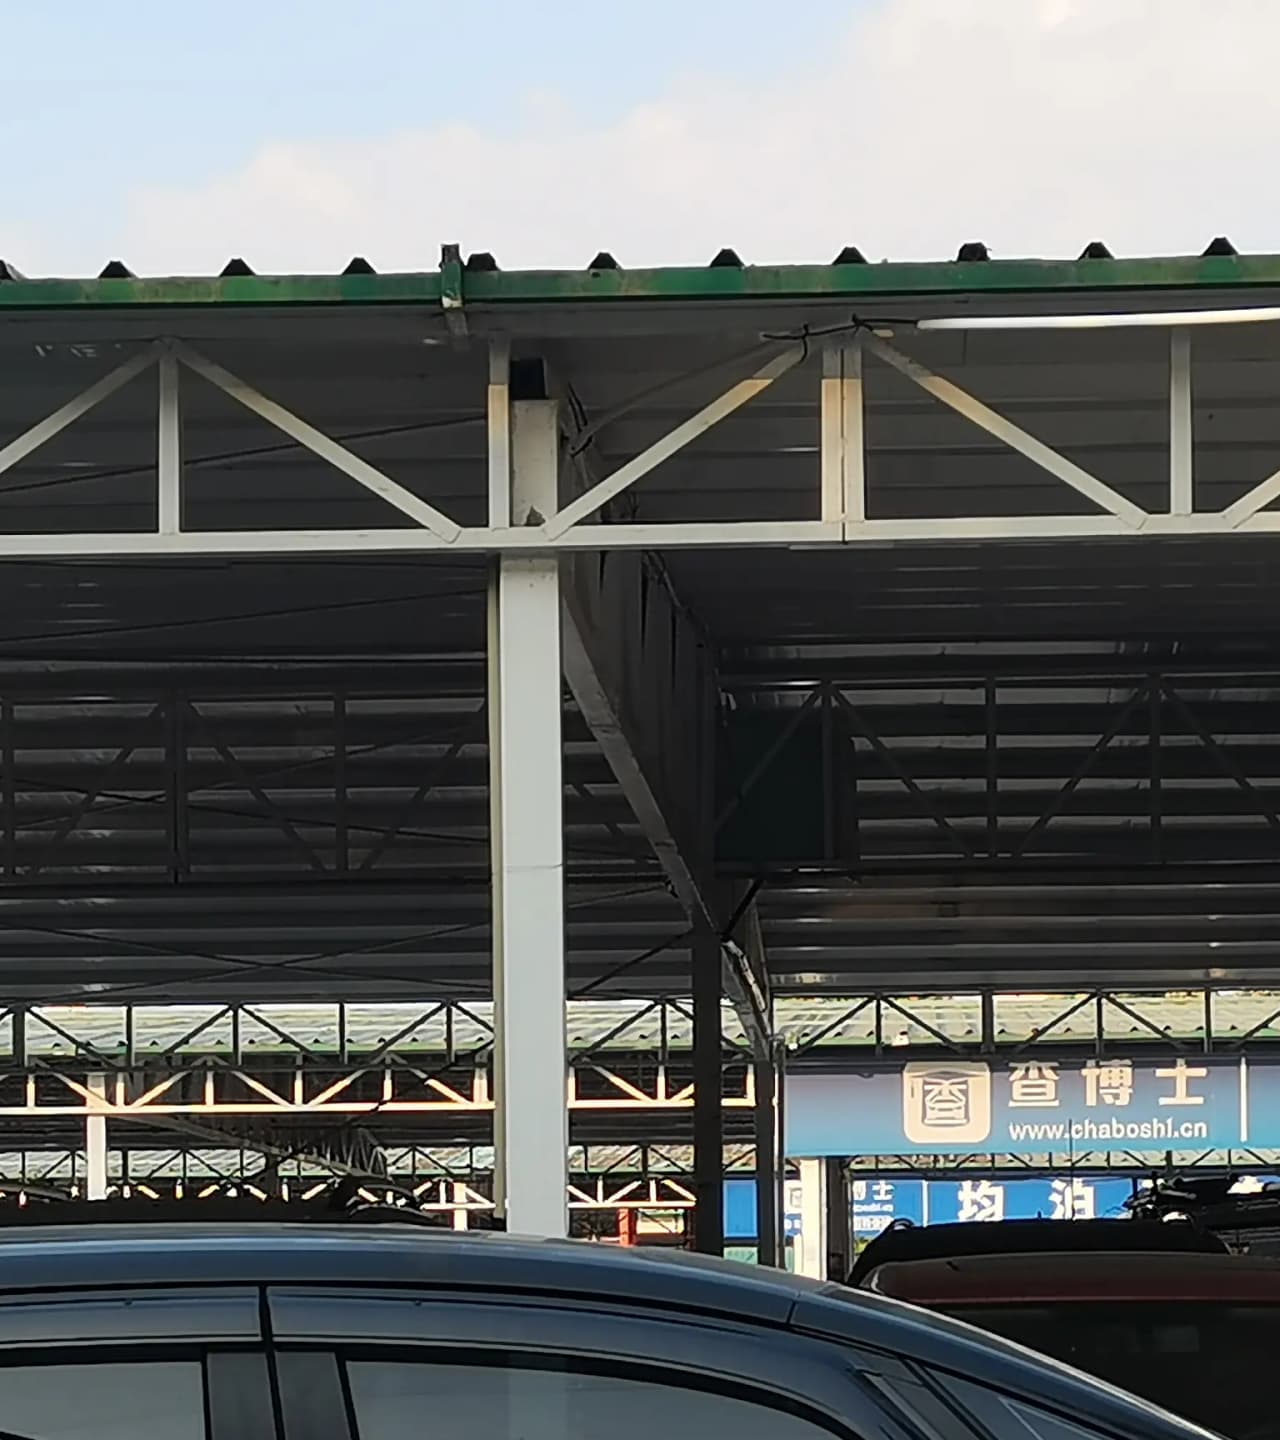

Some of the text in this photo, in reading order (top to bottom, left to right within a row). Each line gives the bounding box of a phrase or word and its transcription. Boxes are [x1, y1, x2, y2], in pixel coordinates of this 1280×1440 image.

[1008, 1058, 1209, 1107] 查博士
[1008, 1117, 1208, 1141] www.chaboshi.cn
